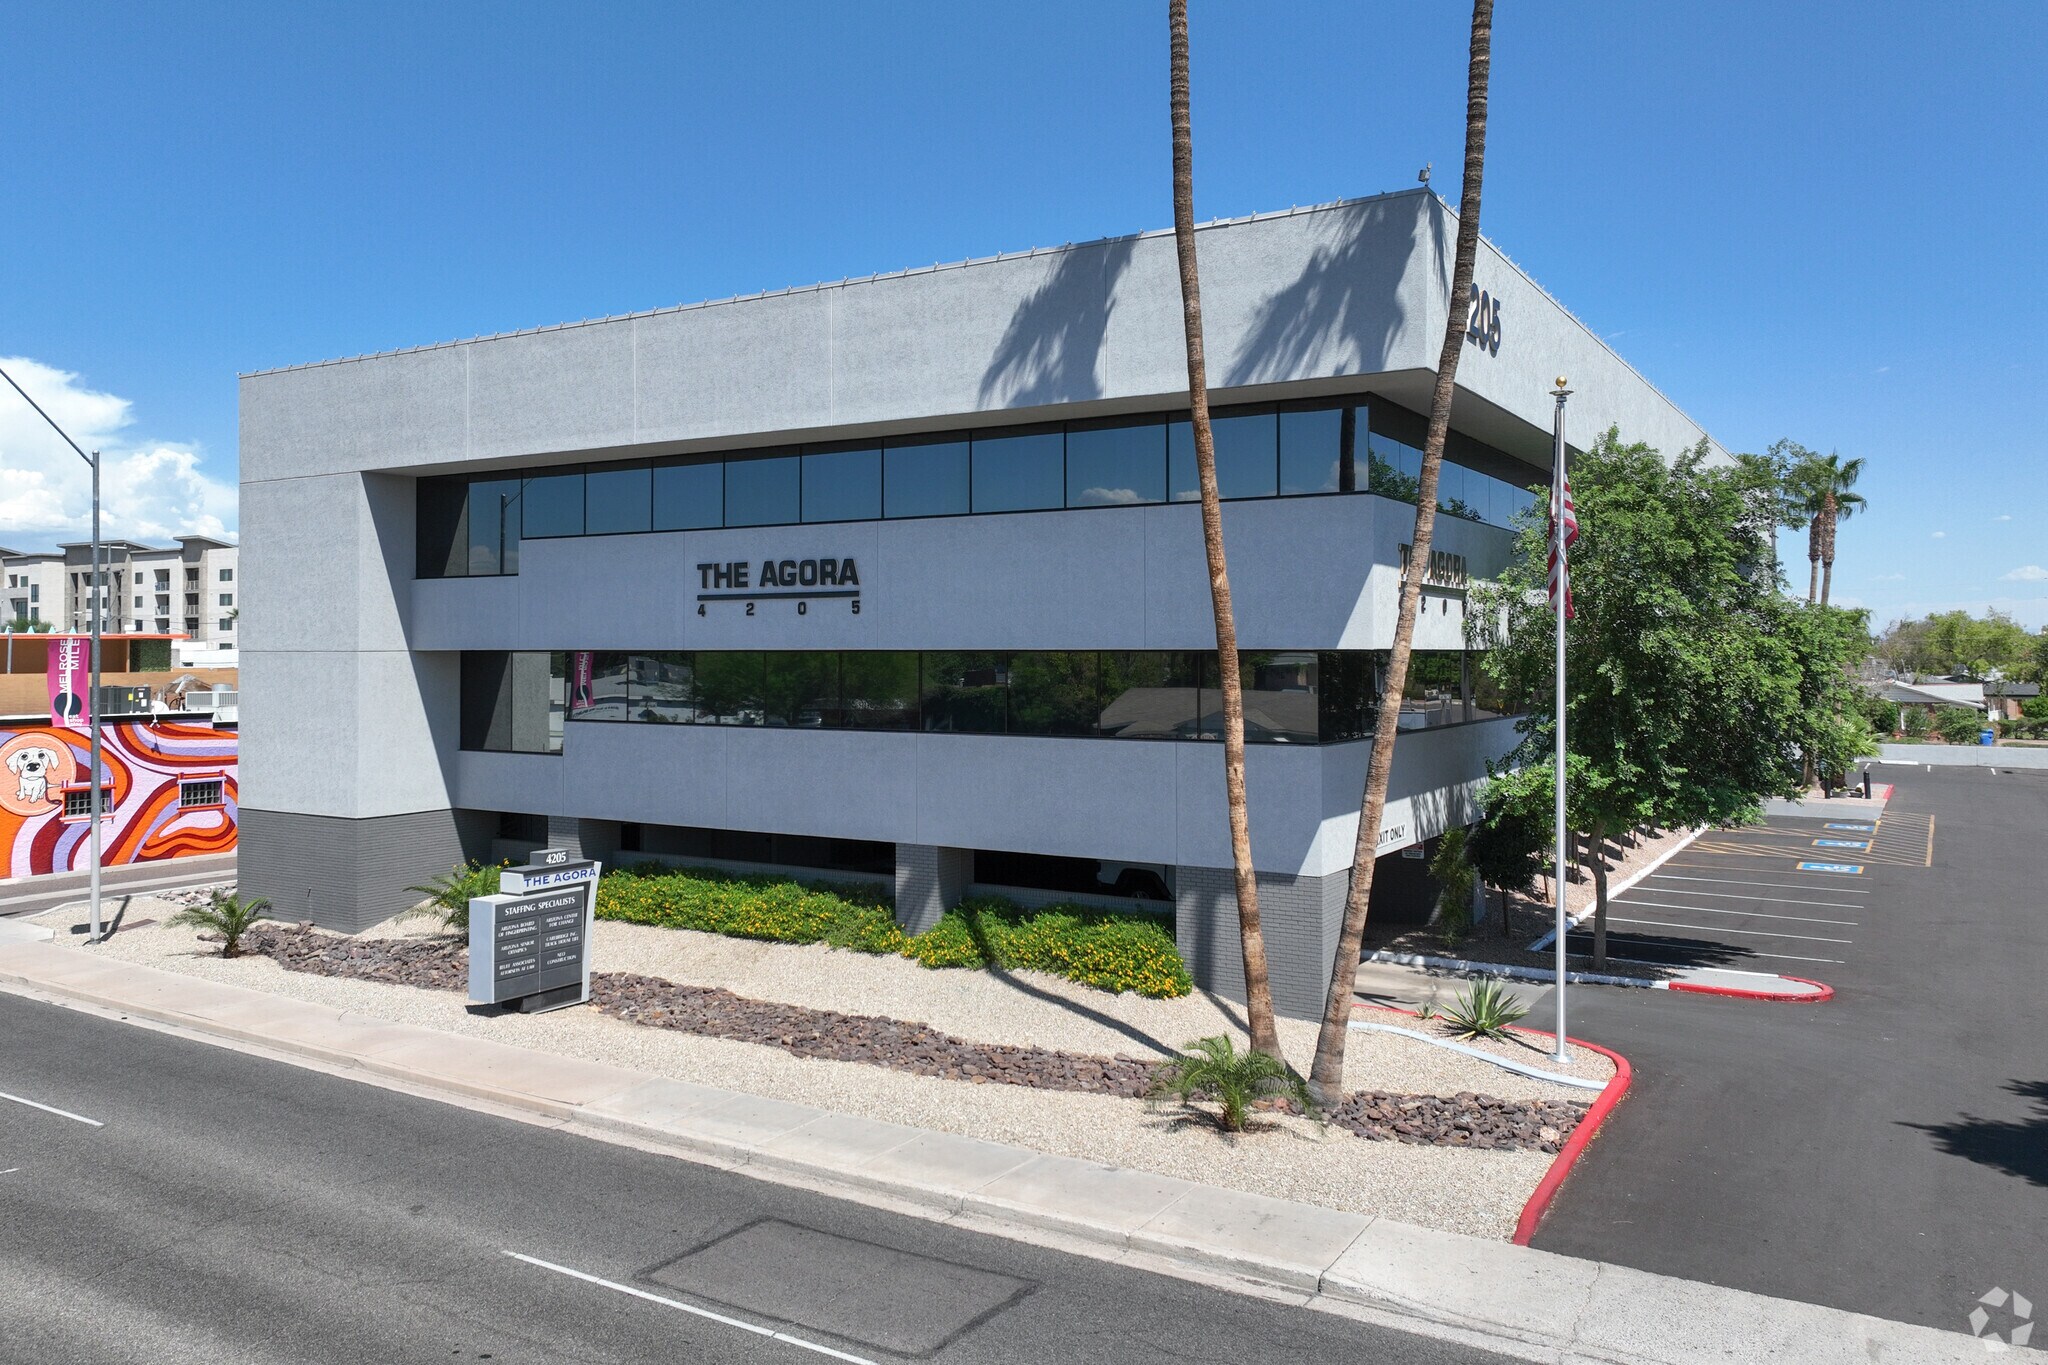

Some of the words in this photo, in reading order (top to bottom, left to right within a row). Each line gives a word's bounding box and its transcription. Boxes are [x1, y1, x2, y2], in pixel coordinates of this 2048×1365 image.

[1469, 282, 1501, 351] 205
[697, 562, 749, 588] THE
[759, 558, 859, 587] AGORA
[1427, 550, 1467, 584] AGORA
[59, 640, 69, 693] MELROSE
[71, 640, 80, 670] MILE
[1376, 830, 1389, 847] XIT
[1390, 824, 1406, 840] ONLY
[546, 852, 566, 864] 4205
[524, 875, 550, 888] THE
[554, 868, 596, 883] AGORA
[505, 904, 536, 916] STAFFING
[538, 896, 576, 910] SPECIALISTS
